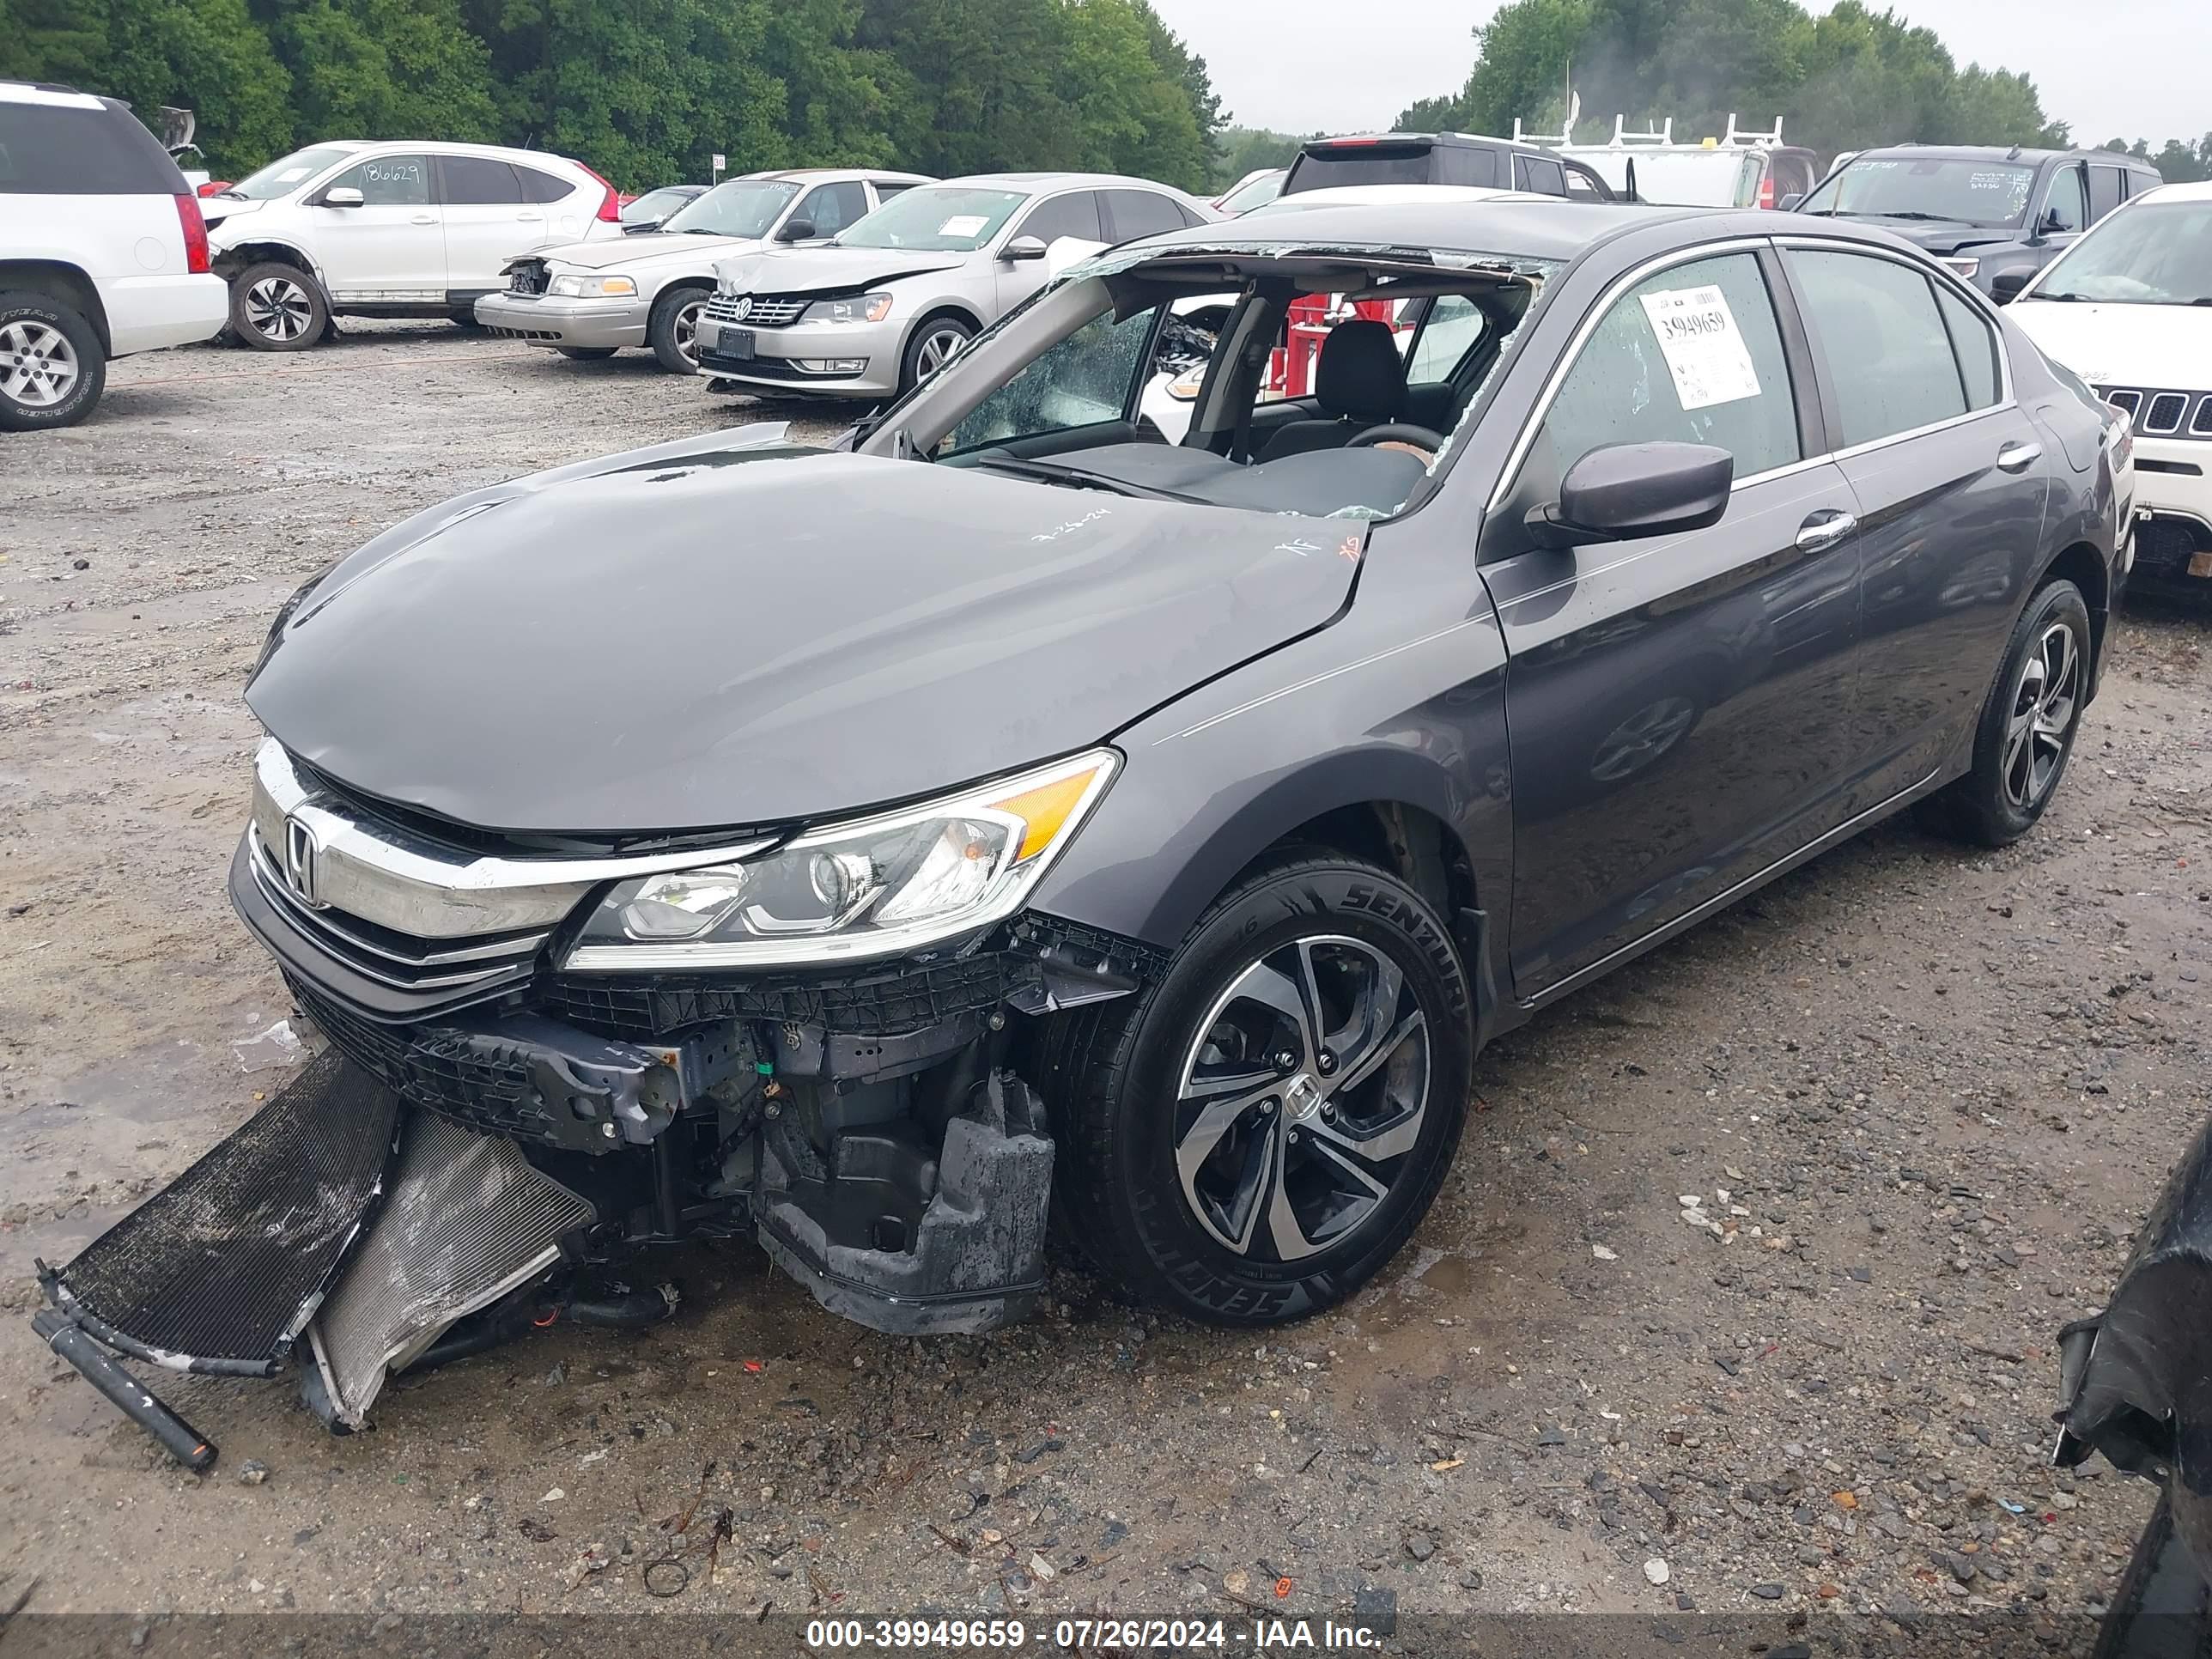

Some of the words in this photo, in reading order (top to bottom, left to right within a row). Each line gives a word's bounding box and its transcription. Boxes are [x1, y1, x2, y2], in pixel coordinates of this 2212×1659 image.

[714, 158, 725, 167] 30
[362, 164, 421, 185] 186629
[1661, 311, 1726, 340] 39949659
